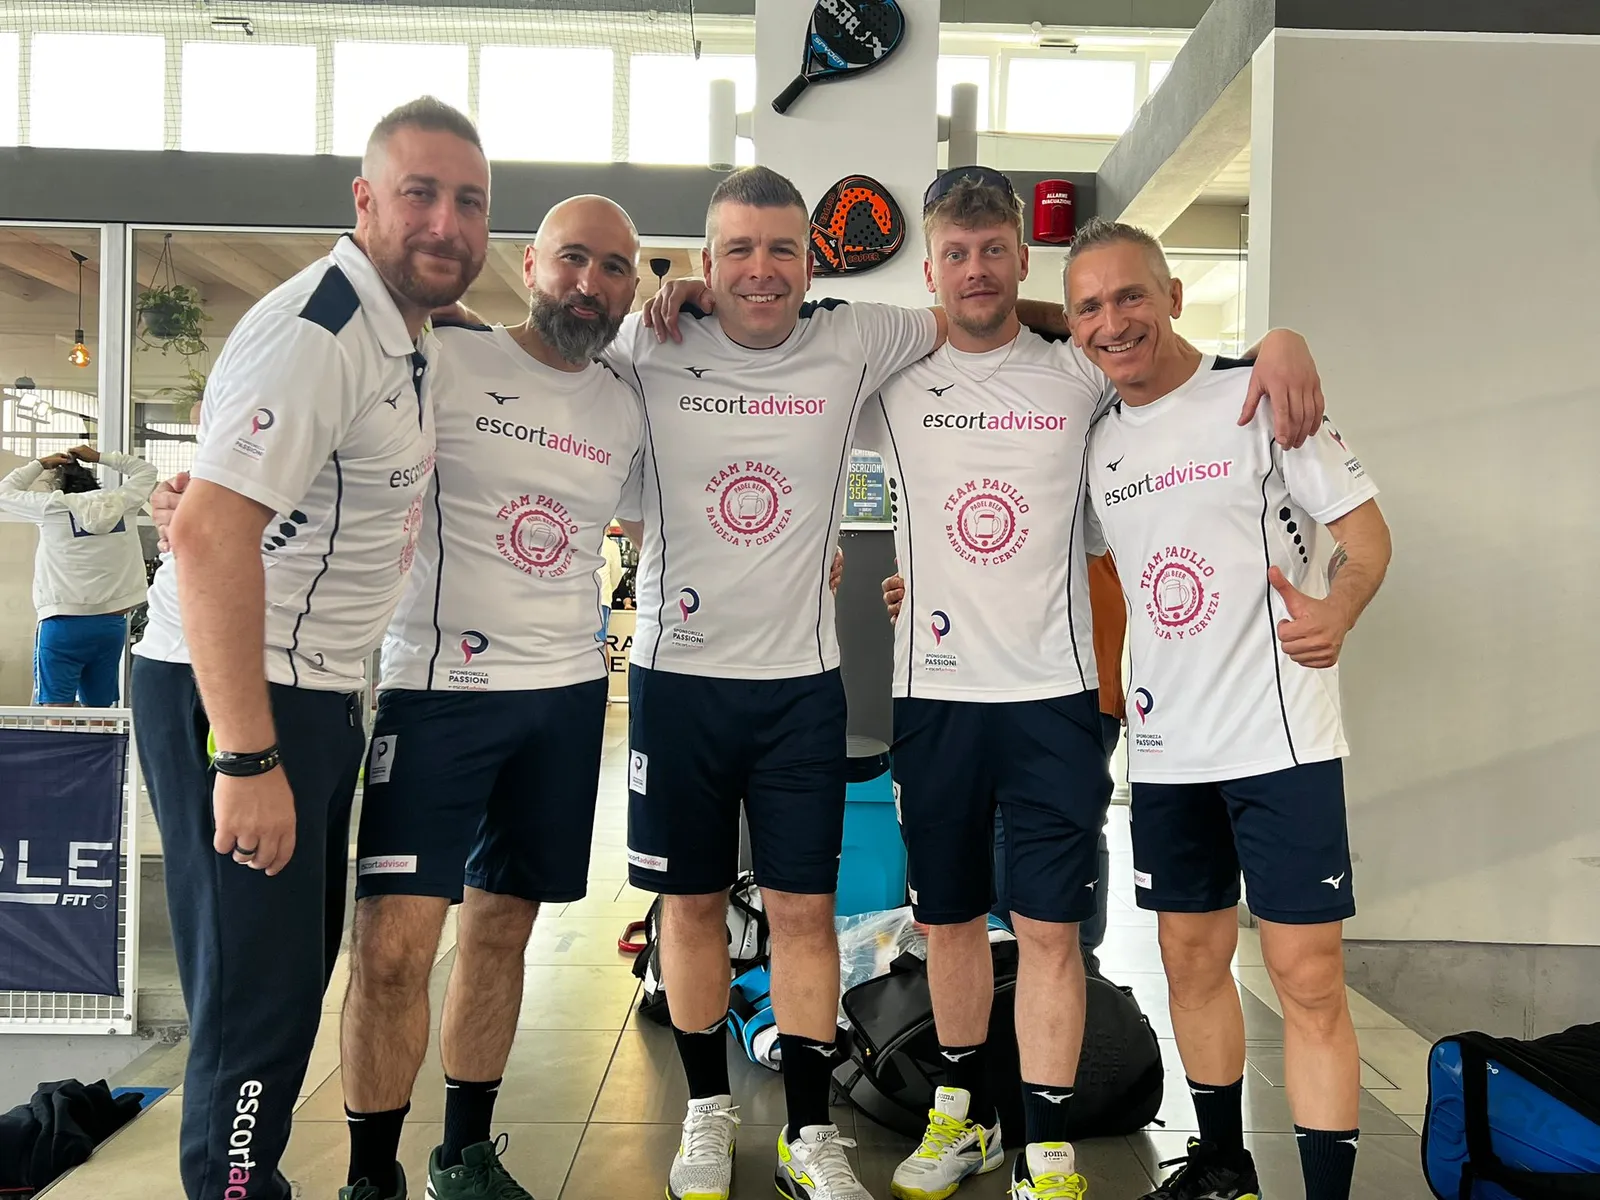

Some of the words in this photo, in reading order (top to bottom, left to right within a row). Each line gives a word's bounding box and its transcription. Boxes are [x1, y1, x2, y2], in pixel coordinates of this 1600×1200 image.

[847, 252, 880, 263] COPPER
[679, 395, 826, 414] escortadvisor
[923, 411, 1067, 430] escortadvisor
[476, 416, 612, 465] escortadvisor
[849, 463, 884, 473] ISCRIZIONI
[705, 463, 740, 493] TEAM
[746, 461, 792, 495] PAULLO
[849, 473, 868, 487] 25€
[1104, 461, 1232, 506] escortadvisor
[734, 483, 751, 493] PADEL
[752, 483, 766, 494] BEER
[848, 487, 868, 500] 35€
[944, 480, 976, 512] TEAM
[982, 479, 1029, 514] PAULLO
[496, 495, 530, 520] TEAM
[536, 495, 578, 534] PAULLO
[970, 501, 987, 511] PADEL
[988, 501, 1003, 512] BEER
[706, 506, 740, 546] BANDEJA
[745, 539, 751, 547] Y
[756, 509, 792, 546] CERVEZA
[945, 525, 977, 564] BANDEJA
[982, 558, 988, 566] Y
[992, 528, 1029, 565] CERVEZA
[496, 534, 533, 574] BANDEJA
[538, 569, 545, 577] Y
[548, 548, 579, 578] CERVEZA
[1140, 552, 1164, 589] TEAM
[1165, 546, 1215, 577] PAULLO
[1171, 570, 1187, 580] BEER
[1177, 631, 1184, 639] Y
[1188, 591, 1220, 636] CERVEZA
[673, 632, 704, 643] PASSIONI
[925, 658, 957, 666] PASSIONI
[449, 675, 489, 684] PASSIONI
[0, 840, 113, 887] LE
[61, 893, 92, 906] FIT
